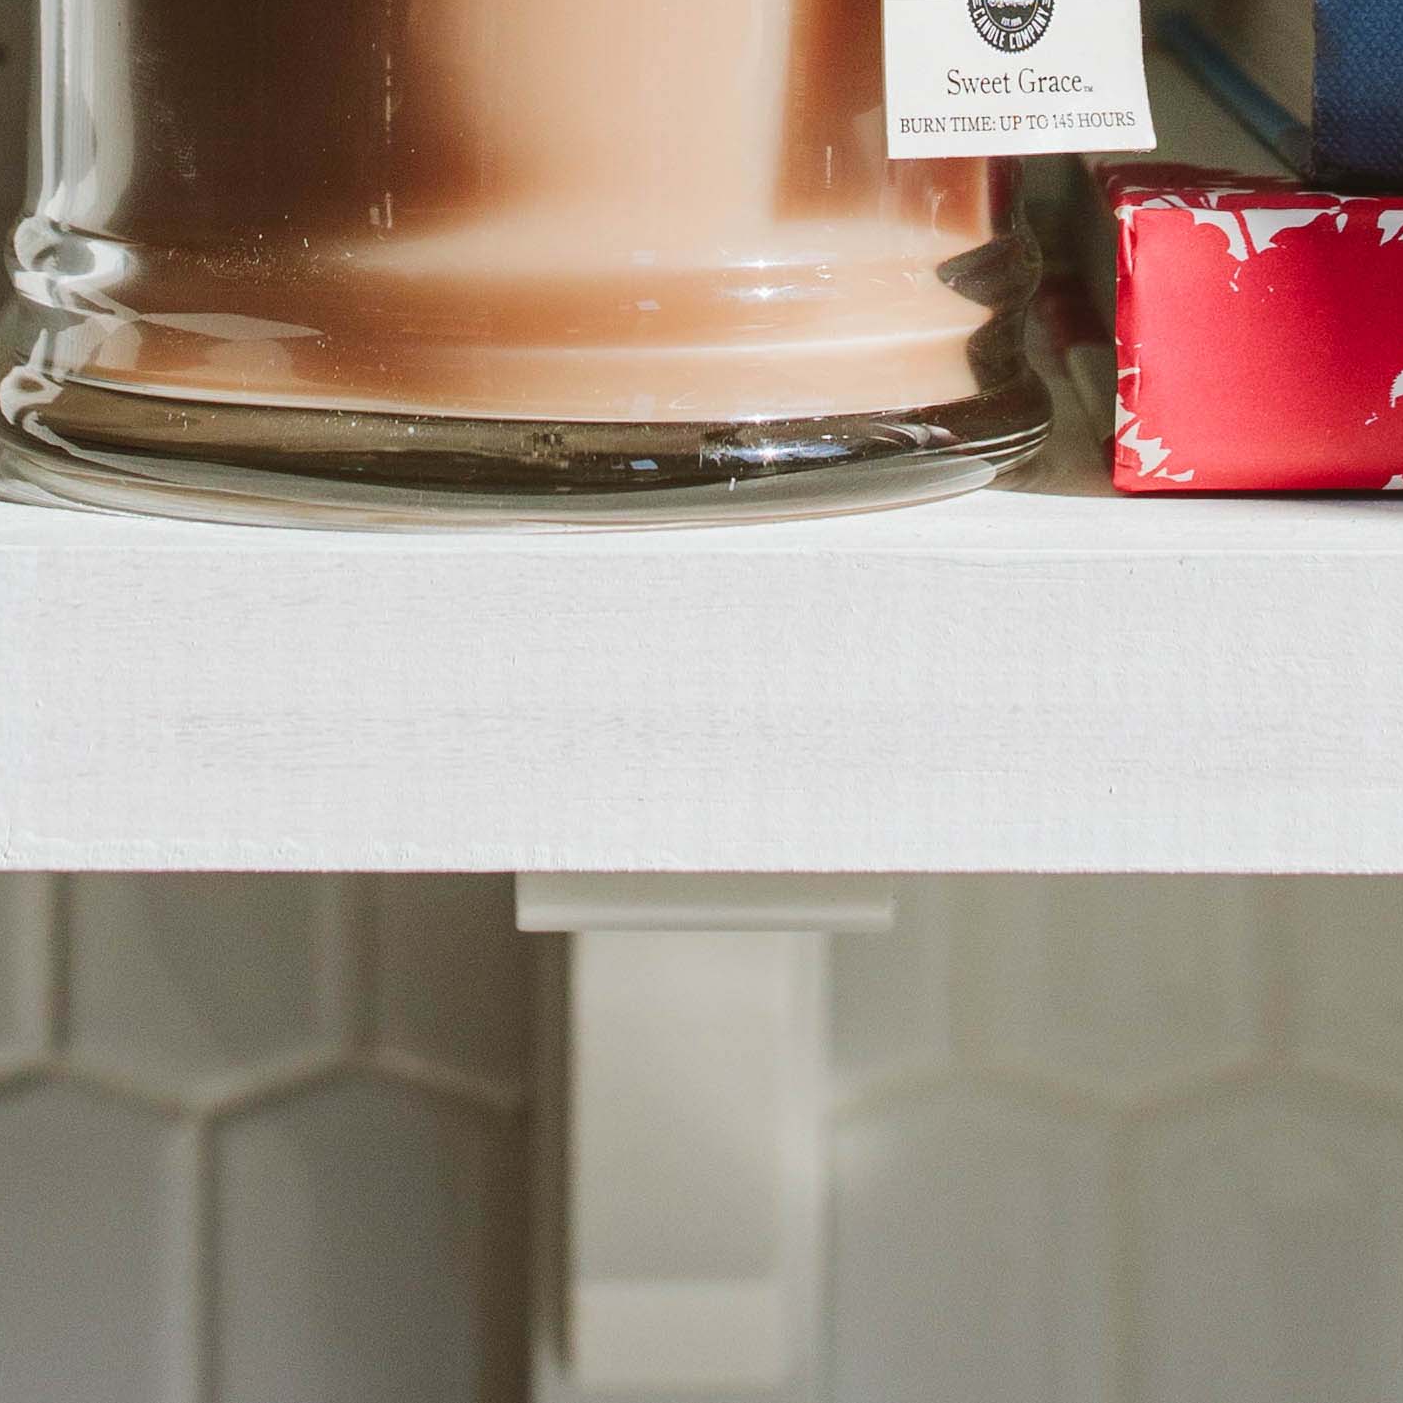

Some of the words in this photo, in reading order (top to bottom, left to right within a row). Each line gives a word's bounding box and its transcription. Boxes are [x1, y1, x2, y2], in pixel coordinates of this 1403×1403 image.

[973, 7, 1006, 48] CANDLE
[1009, 6, 1050, 50] COMPANY
[946, 69, 1011, 96] Sweet
[900, 117, 947, 134] BURN
[950, 117, 996, 132] TIME:
[1000, 116, 1023, 131] UP
[1026, 115, 1049, 130] TO
[1078, 112, 1136, 129] HOURS
